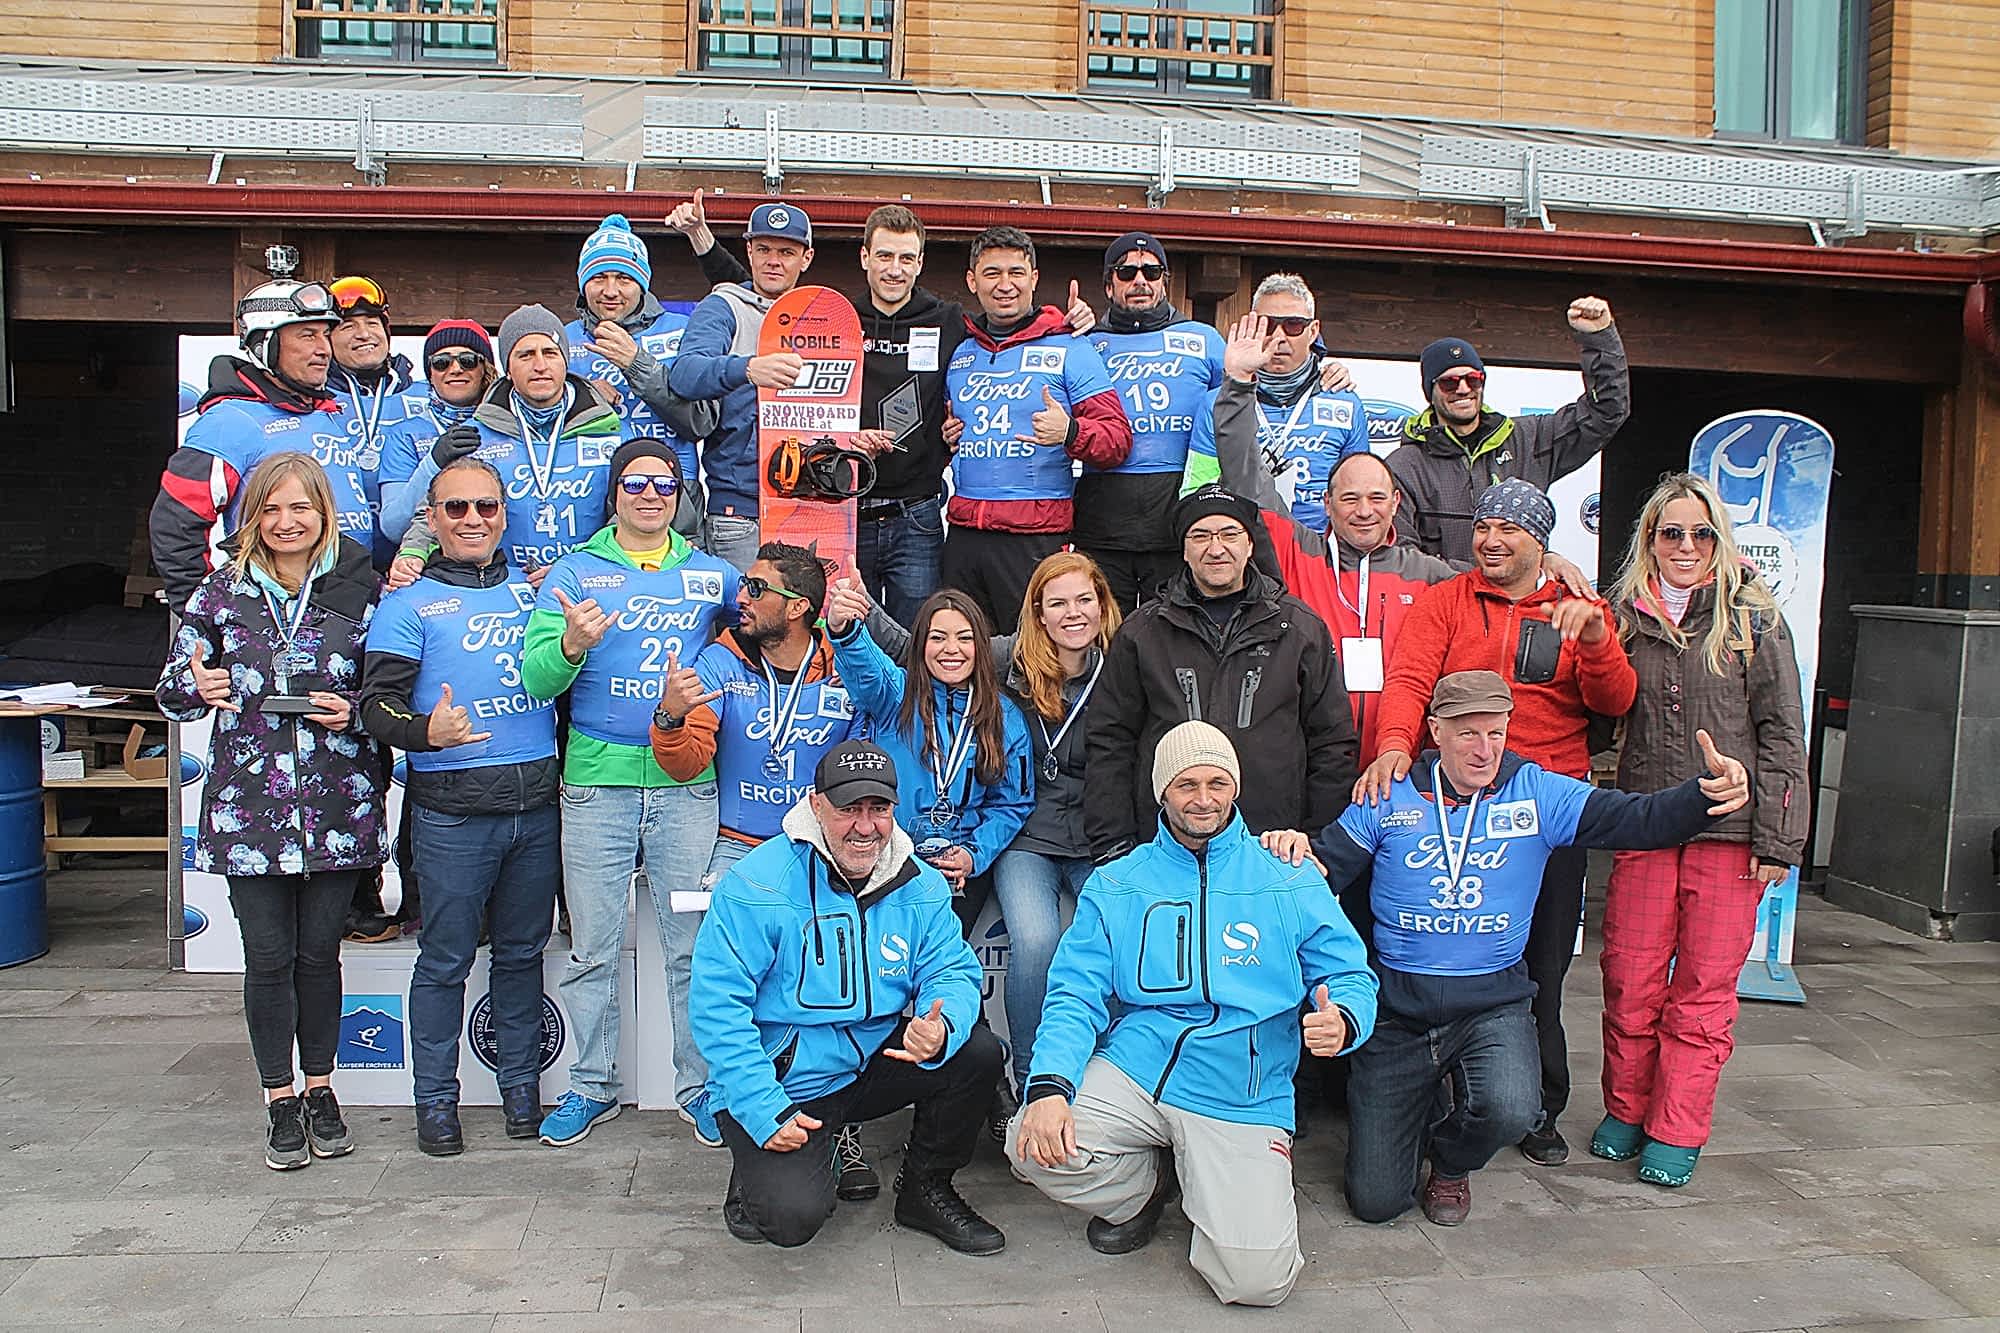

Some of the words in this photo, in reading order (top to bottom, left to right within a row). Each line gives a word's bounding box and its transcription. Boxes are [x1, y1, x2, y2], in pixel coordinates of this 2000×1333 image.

[780, 335, 841, 349] NOBILE
[587, 360, 629, 386] Fo
[1107, 350, 1184, 383] Ford
[958, 370, 1033, 402] Ford
[1124, 381, 1170, 412] 19
[762, 404, 857, 419] SNOWBOARD
[762, 416, 833, 429] GARAGE.at
[972, 404, 1012, 435] 34
[1131, 413, 1193, 433] CİYES
[959, 438, 1036, 458] ERCİYES
[347, 473, 367, 504] 5
[535, 503, 576, 538] 41
[617, 595, 702, 631] Ford
[462, 609, 525, 652] For
[495, 652, 525, 687] 3
[640, 636, 683, 672] 22
[610, 676, 664, 699] ERCİ
[745, 708, 833, 746] Frd
[781, 749, 796, 781] 1
[739, 780, 816, 804] ERCİYE
[1429, 875, 1483, 910] 38
[1398, 911, 1511, 934] ERCİYES
[1221, 955, 1261, 966] IKA
